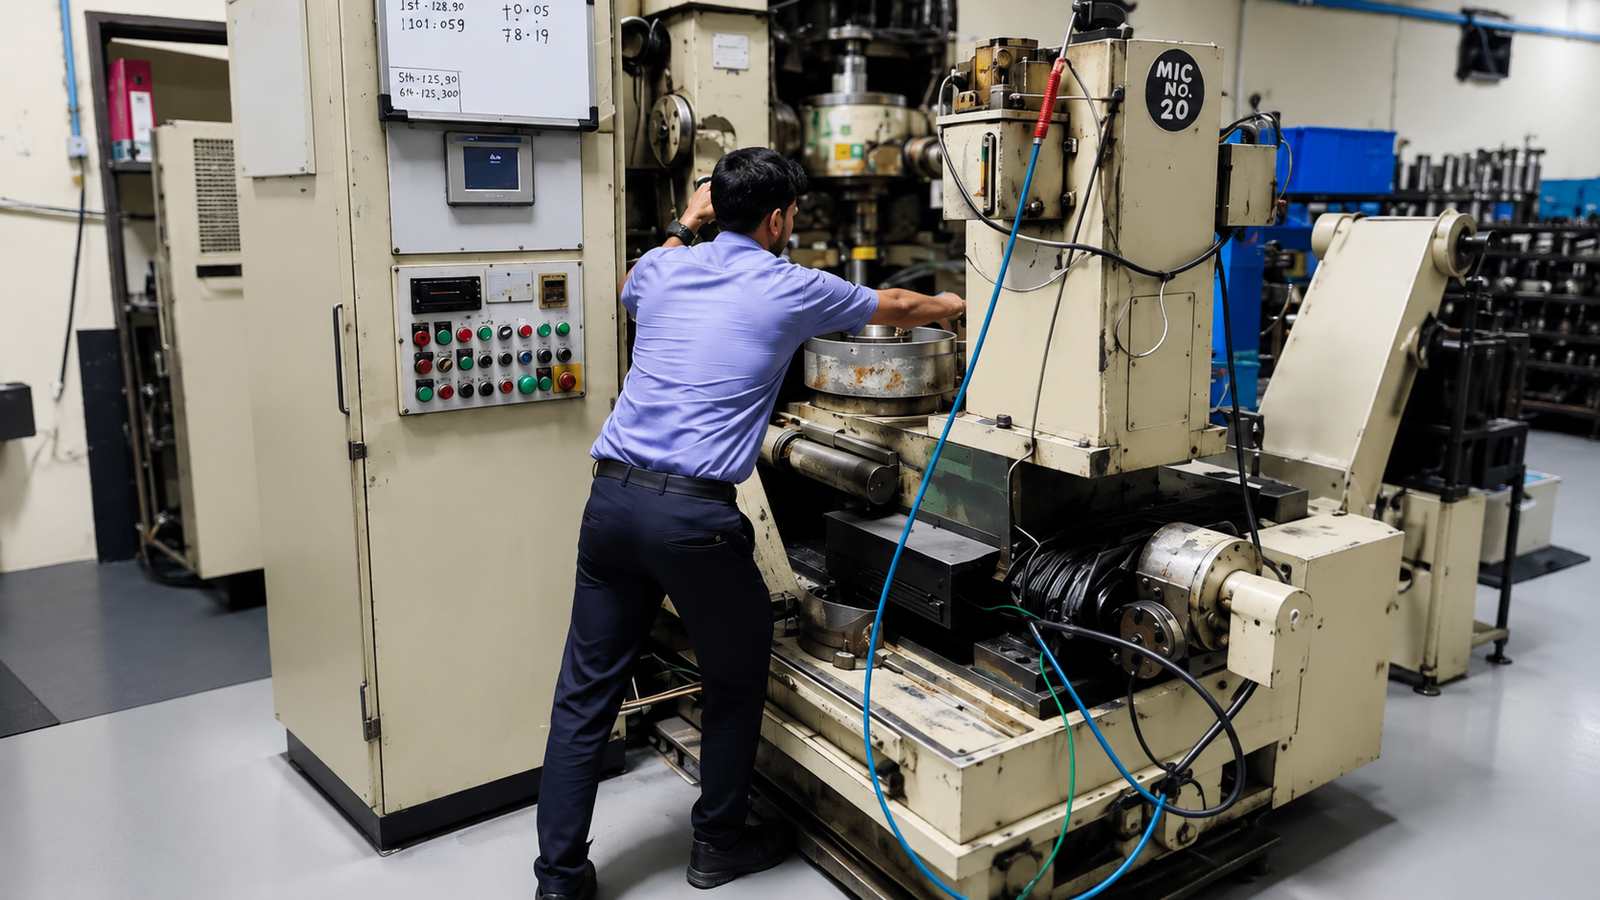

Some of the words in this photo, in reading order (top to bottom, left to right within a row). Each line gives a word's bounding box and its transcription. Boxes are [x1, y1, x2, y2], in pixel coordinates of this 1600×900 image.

[1156, 61, 1193, 83] MIC
[1165, 82, 1192, 98] NO.
[1161, 99, 1189, 120] 20
